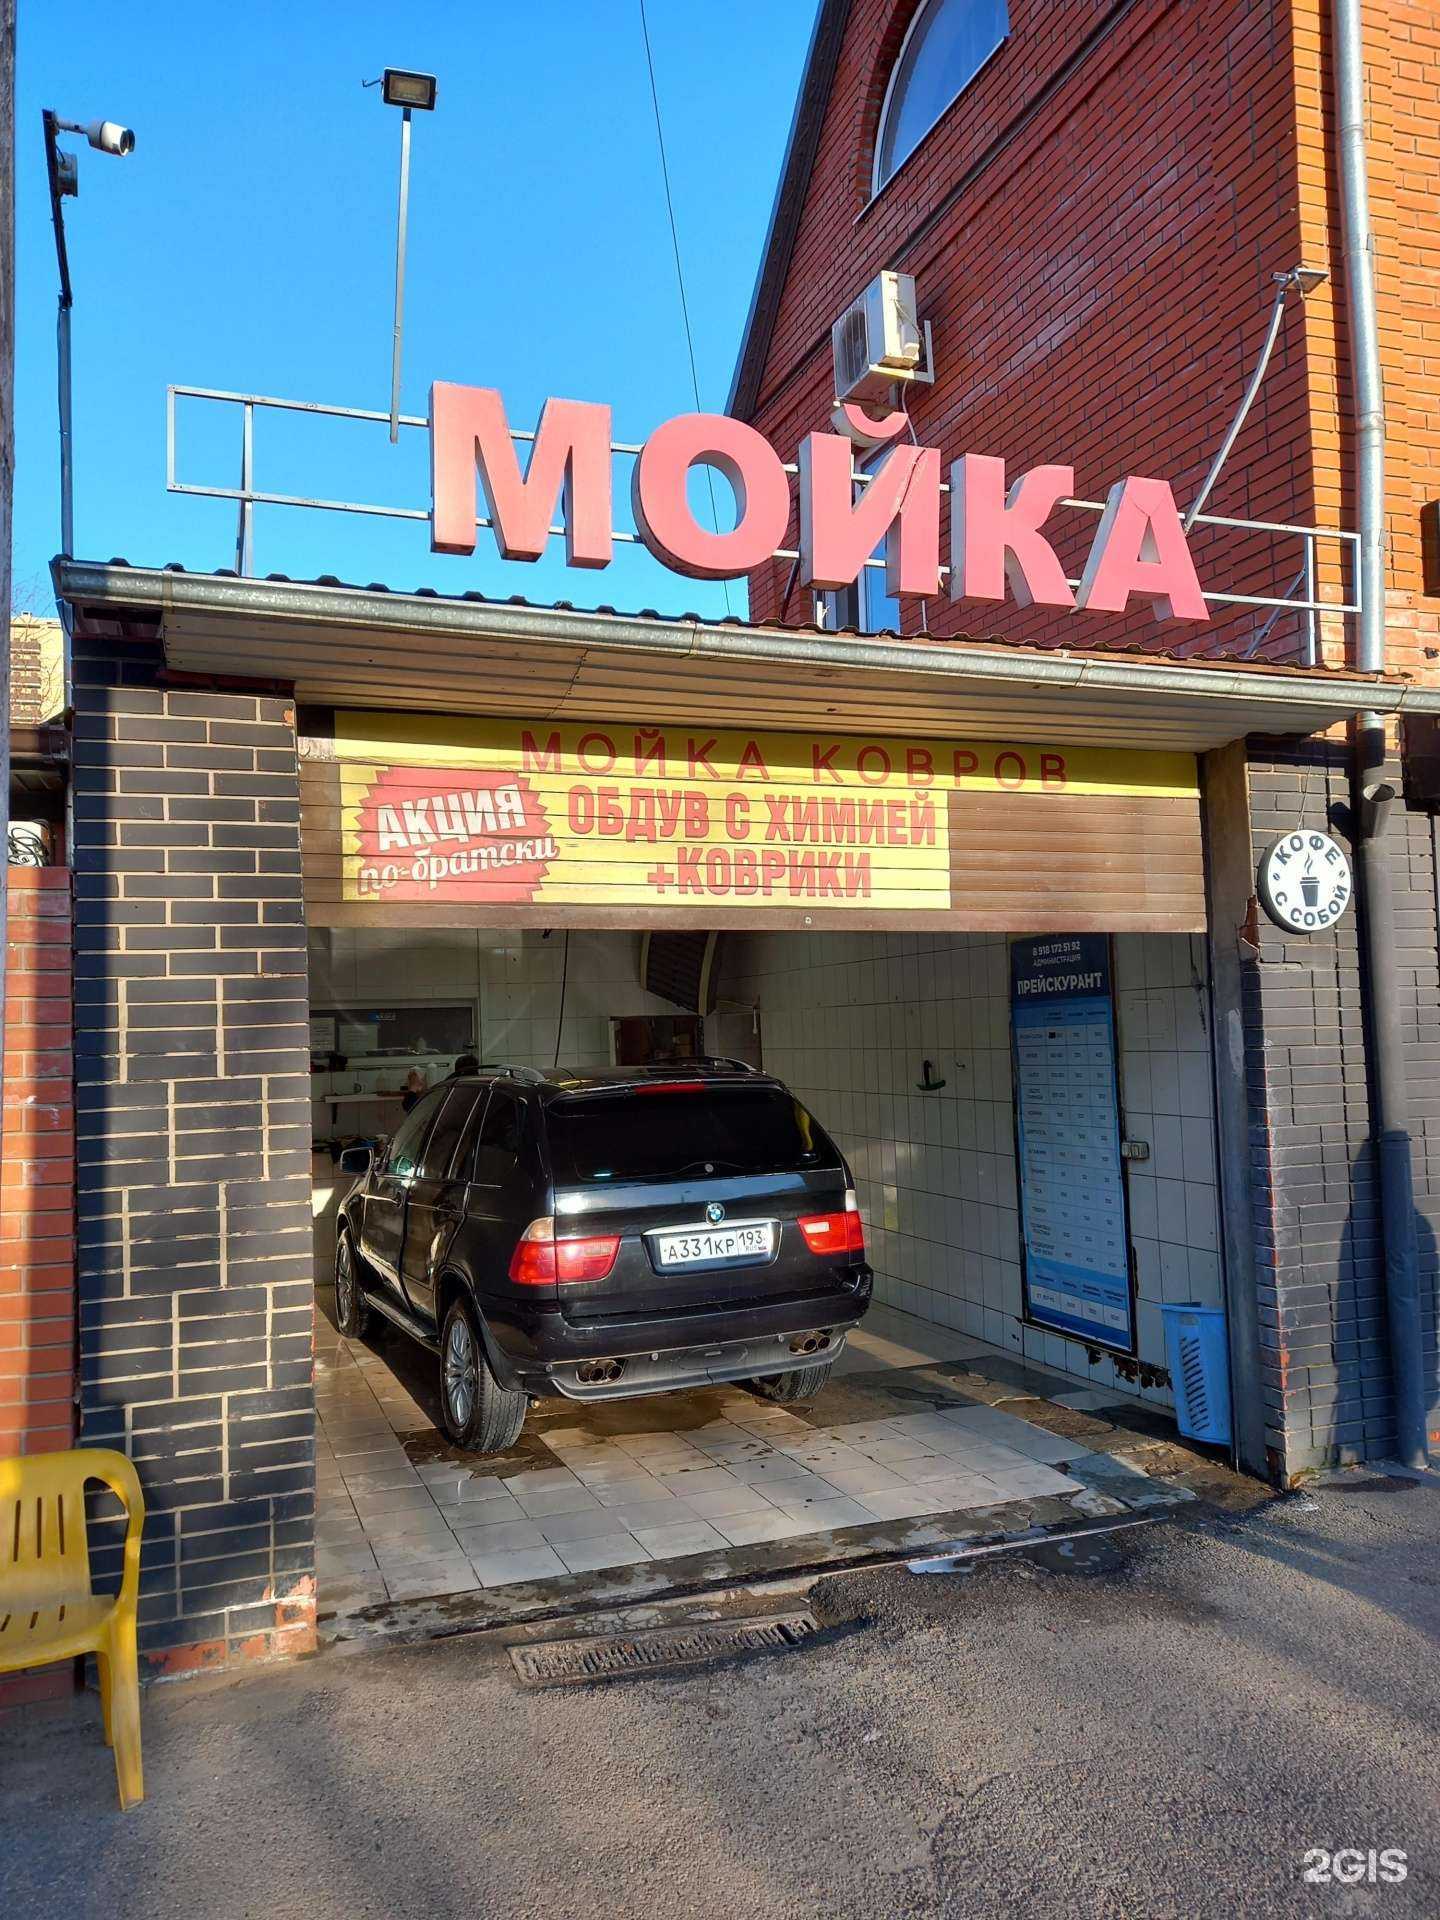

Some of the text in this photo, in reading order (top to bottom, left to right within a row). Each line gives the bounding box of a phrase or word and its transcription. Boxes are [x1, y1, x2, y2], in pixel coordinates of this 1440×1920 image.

[429, 381, 1211, 622] МОЙКА
[521, 728, 1067, 791] МОЙКА КОВРОВ
[376, 783, 528, 851] АКЦИЯ
[567, 784, 936, 846] ОБДУВ С ХИМИЕЙ
[359, 834, 559, 893] по-братски
[646, 846, 872, 898] +КОВРИКИ
[1274, 834, 1341, 866] КОФЕ
[1290, 884, 1348, 927] СОБОЙ
[1017, 972, 1103, 996] ПРЕЙСКУРАНТ
